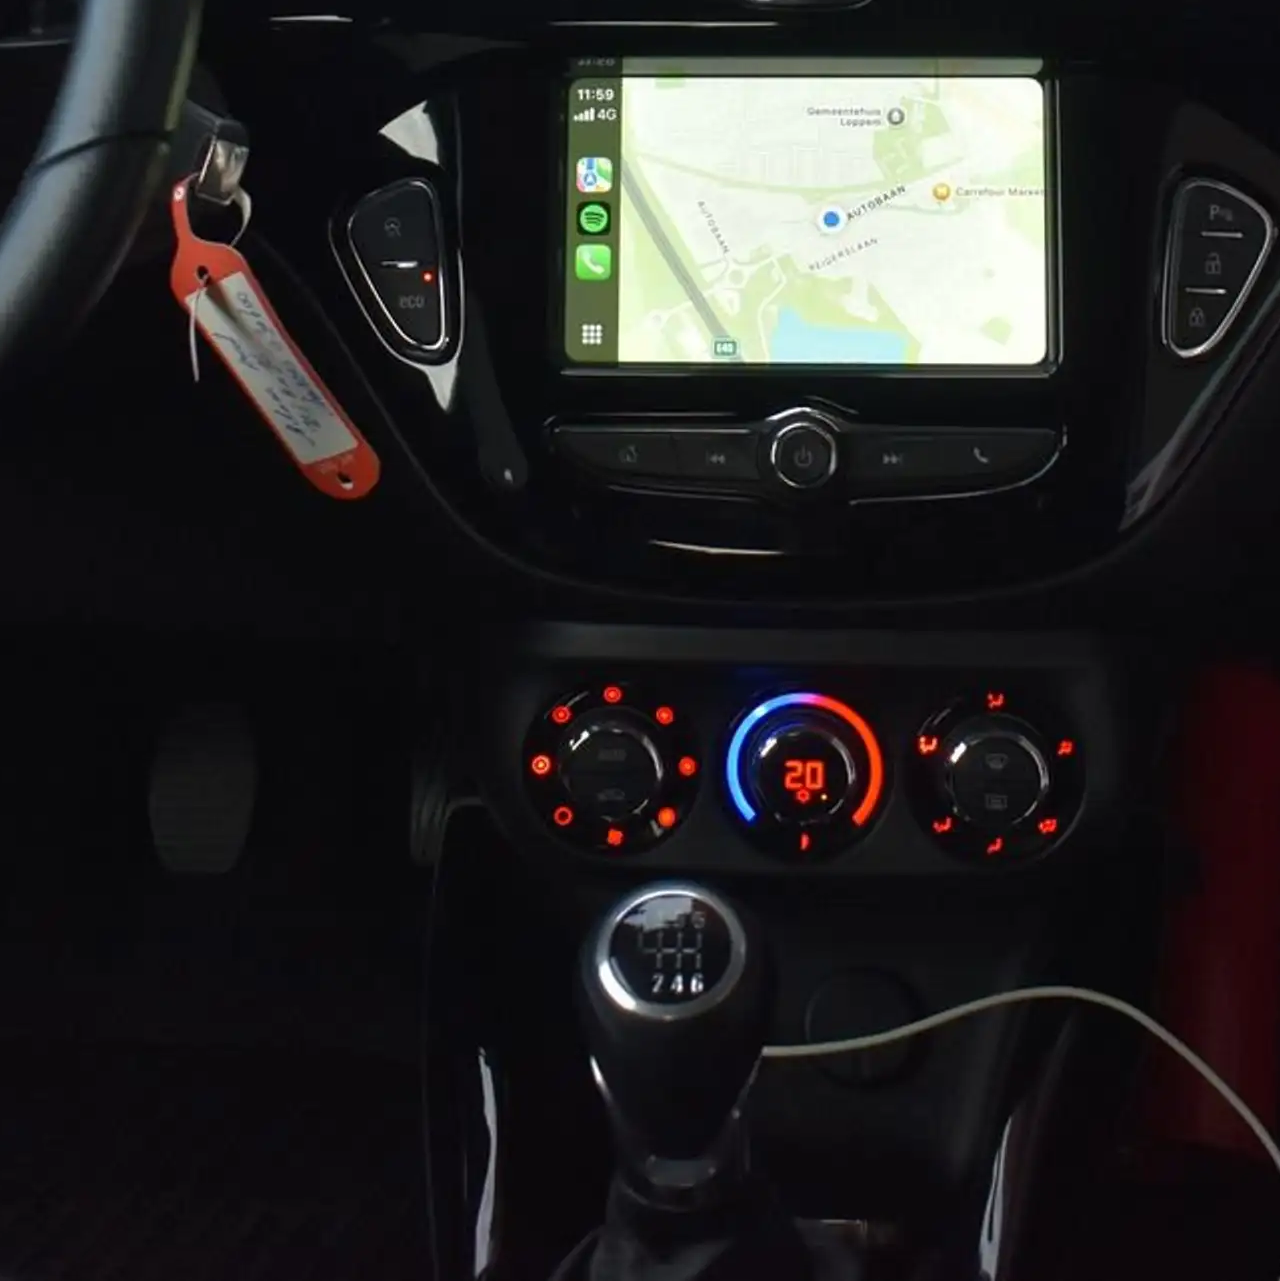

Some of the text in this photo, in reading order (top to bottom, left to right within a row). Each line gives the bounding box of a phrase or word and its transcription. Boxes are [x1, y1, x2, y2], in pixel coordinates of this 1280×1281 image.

[577, 88, 615, 101] 11:59
[596, 108, 617, 121] 4G
[846, 185, 906, 221] AUTOBAAN
[783, 759, 826, 790] 20
[670, 972, 685, 995] 4
[689, 972, 705, 995] 6
